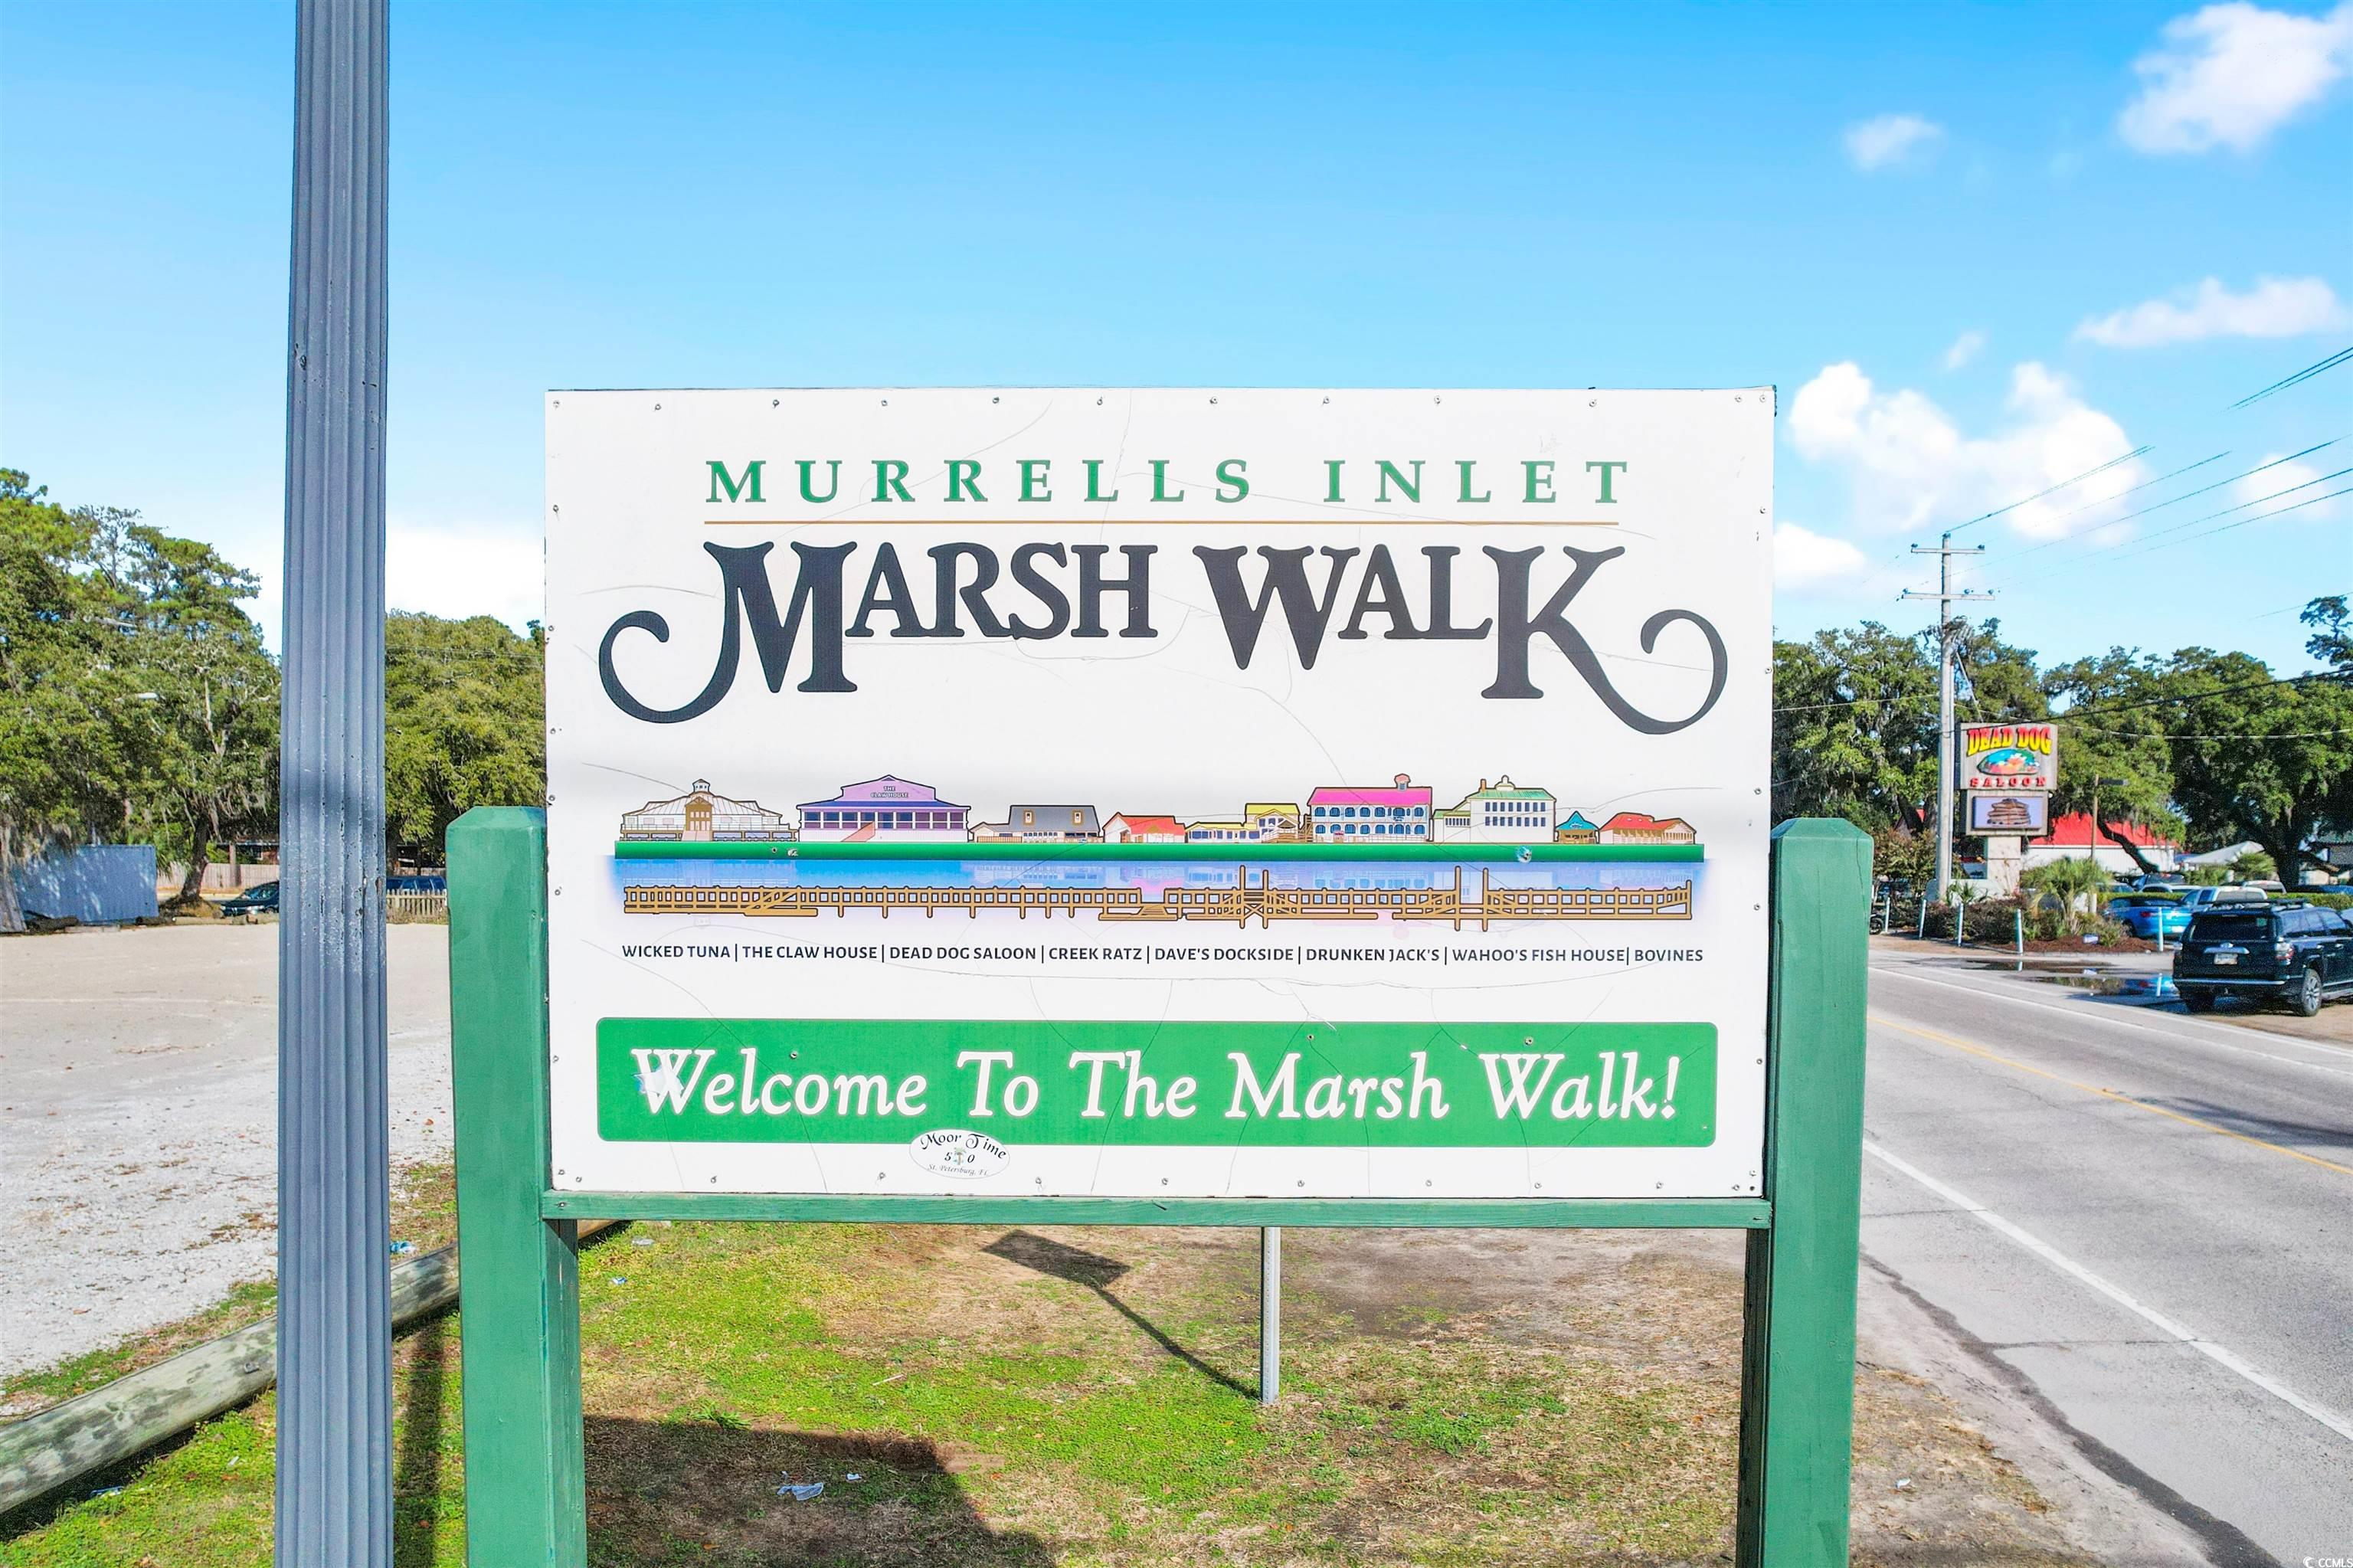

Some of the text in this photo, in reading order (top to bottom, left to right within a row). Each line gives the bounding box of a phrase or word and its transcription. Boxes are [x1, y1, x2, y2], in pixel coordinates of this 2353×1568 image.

[705, 460, 1628, 503] MURRELLS INLET
[599, 541, 1728, 735] MARSH WALK
[1967, 726, 2053, 757] DEAD DOG
[1970, 776, 2047, 787] SALOON
[622, 945, 1703, 962] WICKED TUNA THE CLAW HOUSE DEAD DOG SALOON CREEK RATZ DAVE'S DOCKSIDE DRUNKEN JACK'S WAHOO'S FISH HOUSE BOVINES
[630, 1046, 1679, 1121] Welcome To The Marsh Walk!
[921, 1133, 1006, 1159] Moor Time
